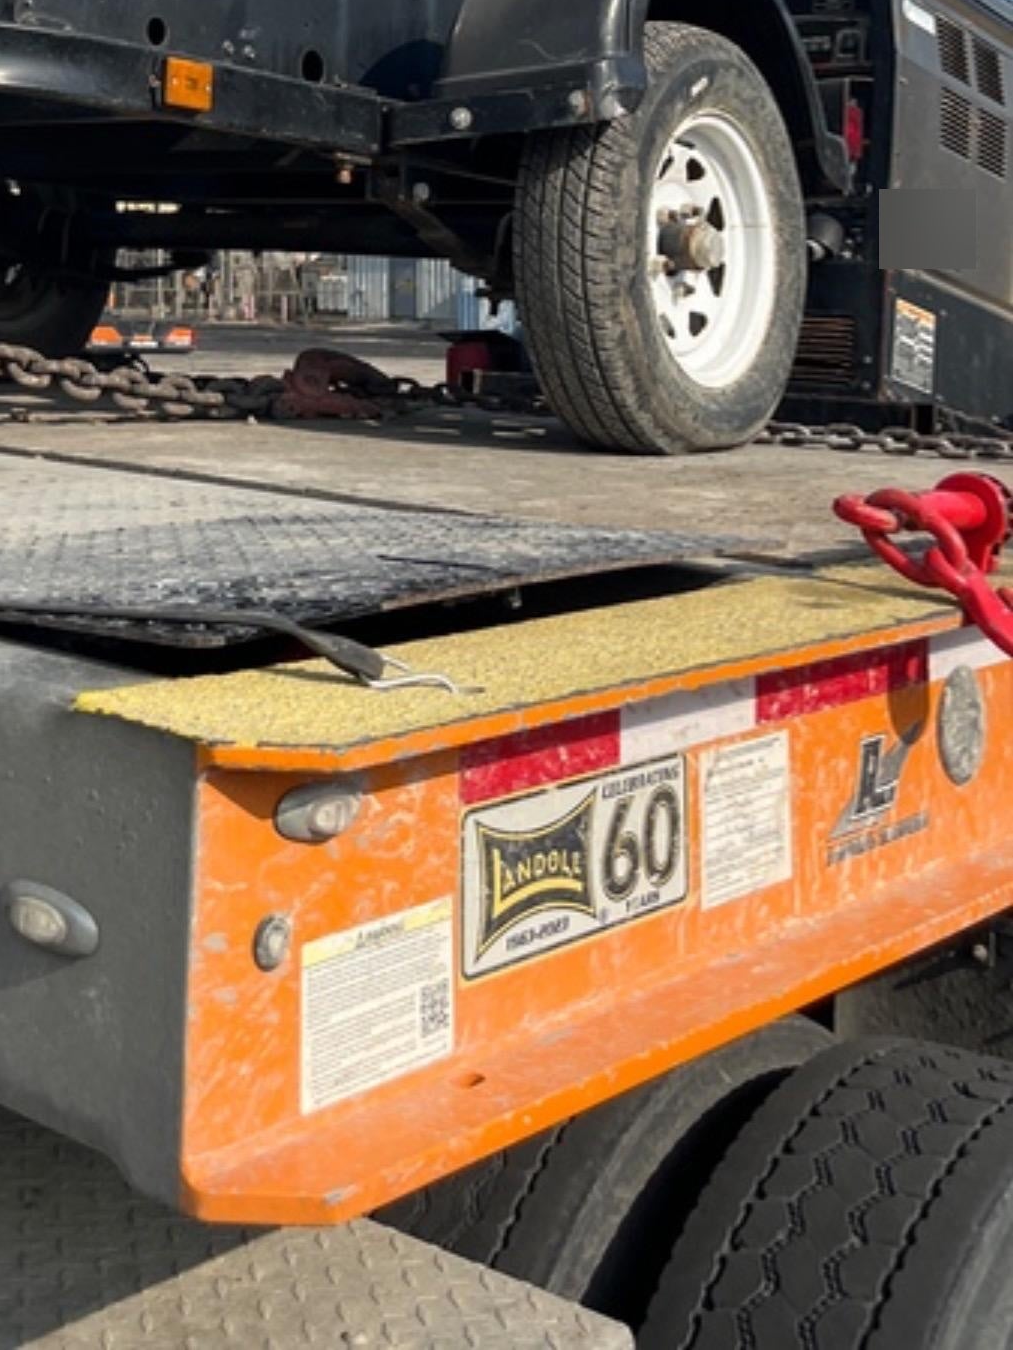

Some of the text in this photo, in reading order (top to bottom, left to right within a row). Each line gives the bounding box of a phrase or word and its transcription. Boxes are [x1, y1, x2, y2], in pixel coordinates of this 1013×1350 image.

[601, 764, 679, 800] CELEBRATING
[603, 783, 680, 901] 60
[492, 847, 585, 918] LANDOLL
